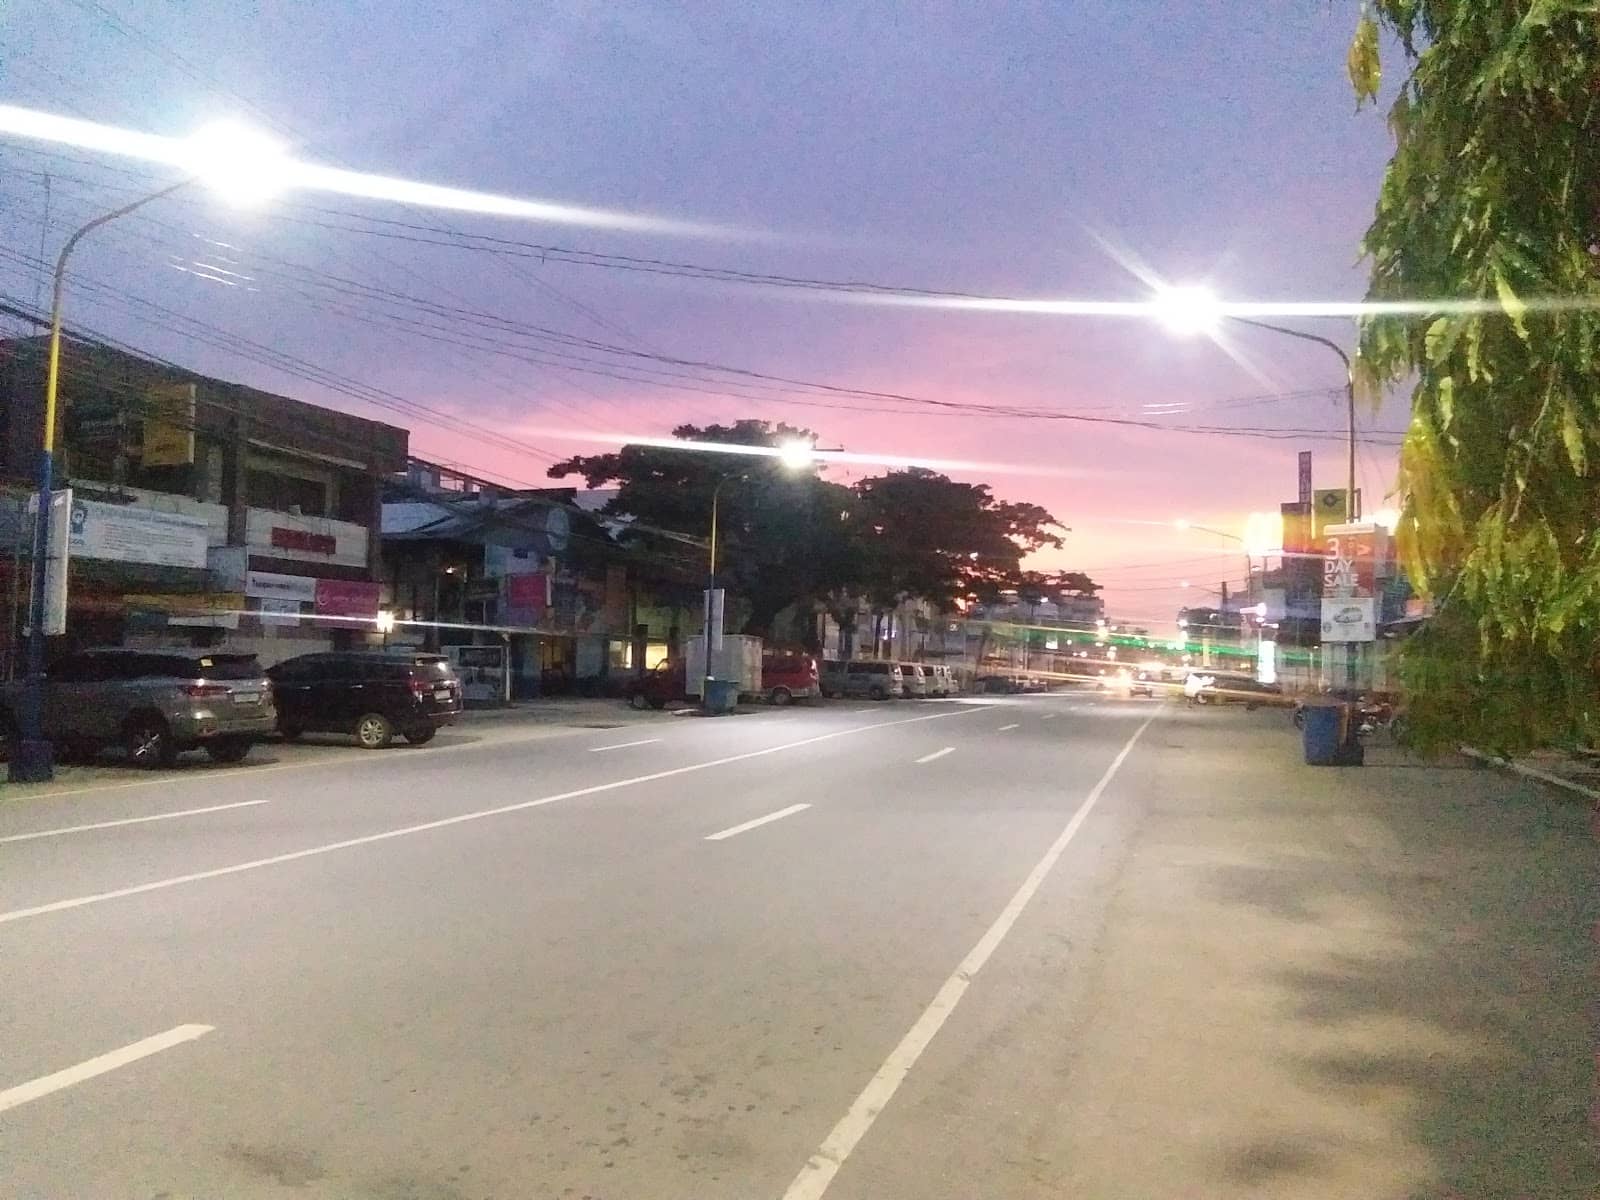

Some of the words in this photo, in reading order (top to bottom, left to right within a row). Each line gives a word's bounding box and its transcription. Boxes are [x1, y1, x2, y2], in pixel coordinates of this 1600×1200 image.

[1327, 538, 1340, 560] 3
[1325, 560, 1352, 573] DAY
[1324, 574, 1359, 587] SALE
